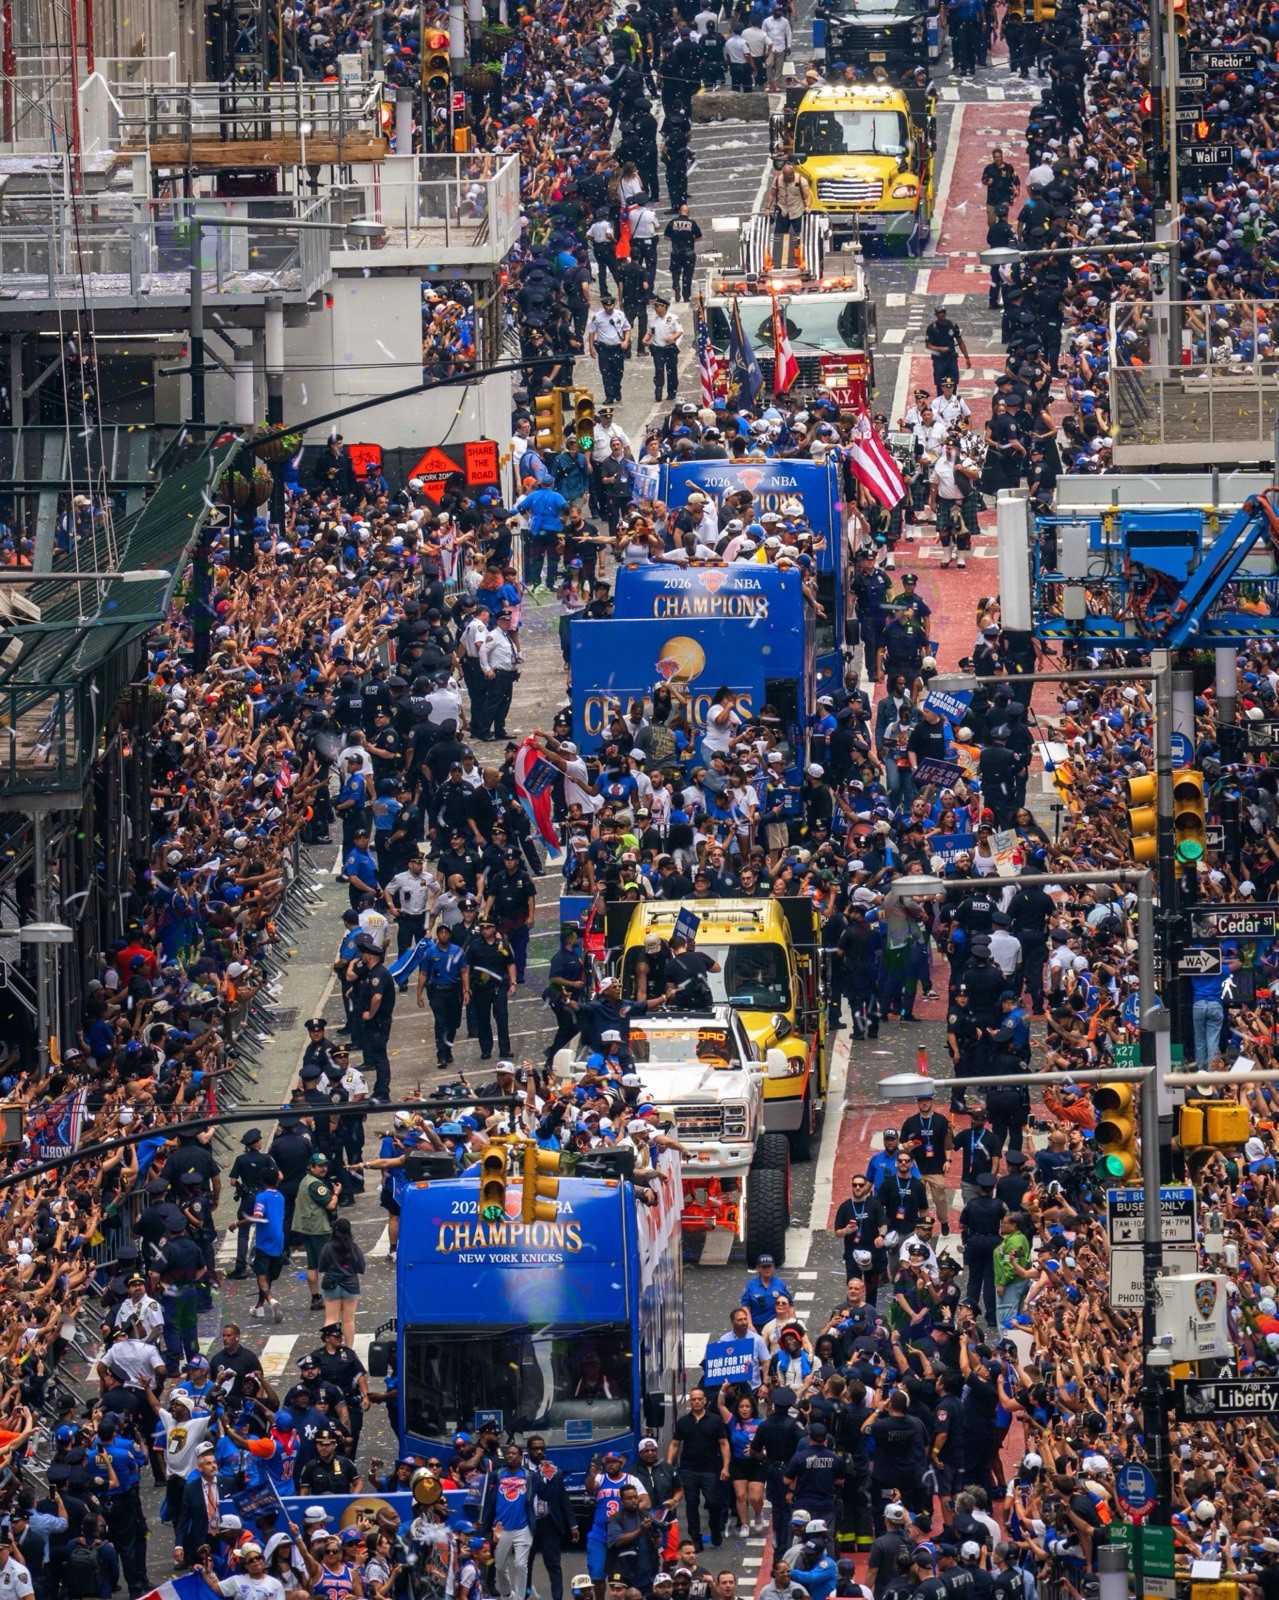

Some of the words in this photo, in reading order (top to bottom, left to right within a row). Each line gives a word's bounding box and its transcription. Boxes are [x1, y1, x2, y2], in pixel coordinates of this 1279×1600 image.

[1211, 57, 1242, 67] Rector
[1196, 151, 1218, 163] Wall
[468, 446, 493, 456] SHARE
[474, 459, 489, 467] THE
[472, 471, 493, 480] ROAD
[705, 477, 731, 487] 2026
[771, 476, 797, 486] NBA
[664, 579, 691, 589] 2026
[734, 579, 761, 589] NBA
[654, 596, 768, 618] CHAMPIONS
[944, 694, 955, 705] FOR
[928, 696, 958, 716] BOROUGHS
[920, 766, 944, 776] LET'S
[1218, 919, 1260, 933] Cedar
[1264, 917, 1272, 925] ST
[1186, 957, 1210, 966] WAY
[1133, 1192, 1145, 1200] BU
[1117, 1203, 1144, 1211] BUSE
[436, 1221, 582, 1253] CHAMPIONS
[458, 1254, 486, 1263] NEW
[489, 1254, 519, 1263] YORK
[522, 1253, 563, 1262] KNICKS
[708, 1358, 723, 1368] WON
[725, 1357, 737, 1366] FOR
[740, 1354, 752, 1364] THE
[708, 1365, 745, 1378] BOROUGHS
[1219, 1390, 1278, 1410] Liberty
[305, 1424, 318, 1440] NY
[806, 1457, 834, 1468] FDNY
[1111, 1526, 1127, 1538] SIM2
